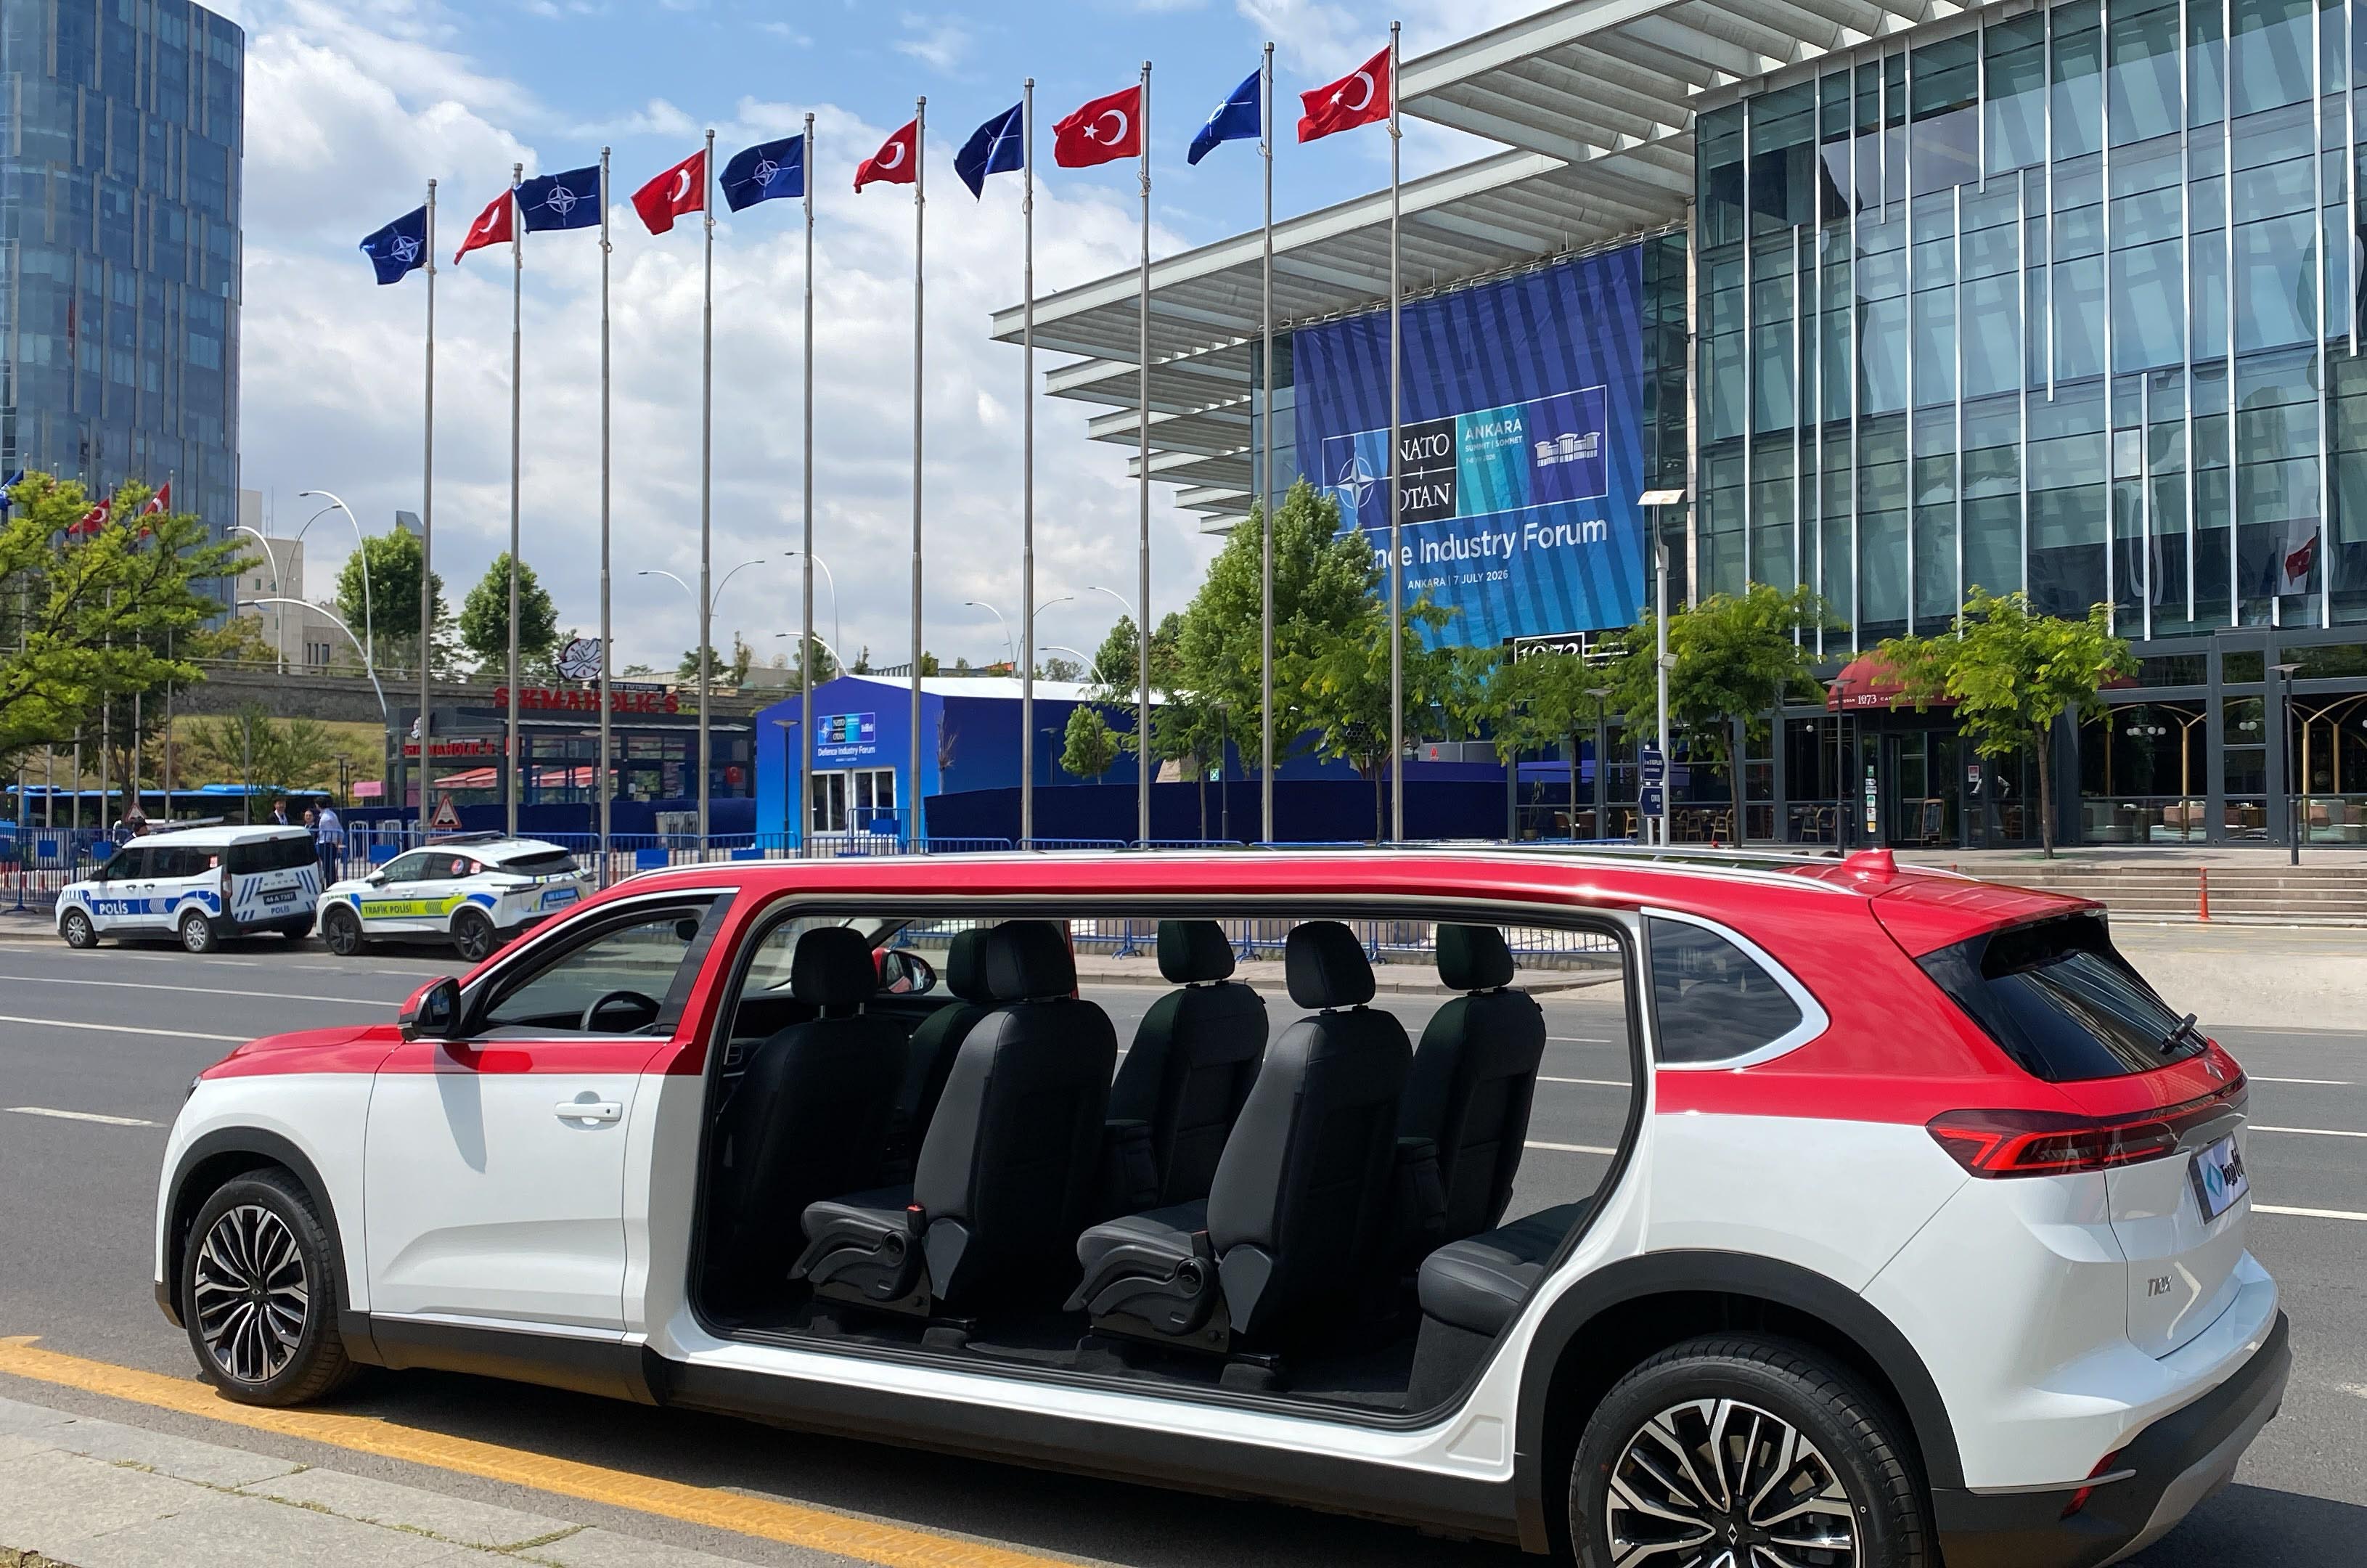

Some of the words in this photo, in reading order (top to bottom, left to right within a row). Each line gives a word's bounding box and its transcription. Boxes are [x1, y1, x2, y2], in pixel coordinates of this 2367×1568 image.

[1465, 418, 1523, 441] ANKARA
[1465, 441, 1490, 452] SUMMIT
[1495, 436, 1523, 448] SOMMET
[1420, 531, 1516, 564] Industry
[1524, 518, 1608, 551] Forum
[1407, 578, 1446, 590] ANKARA
[1454, 576, 1459, 585] 7
[1461, 573, 1484, 584] JULY
[1486, 570, 1508, 581] 2026
[817, 747, 837, 756] Defence
[838, 746, 858, 756] Industry
[859, 746, 875, 754] Forum
